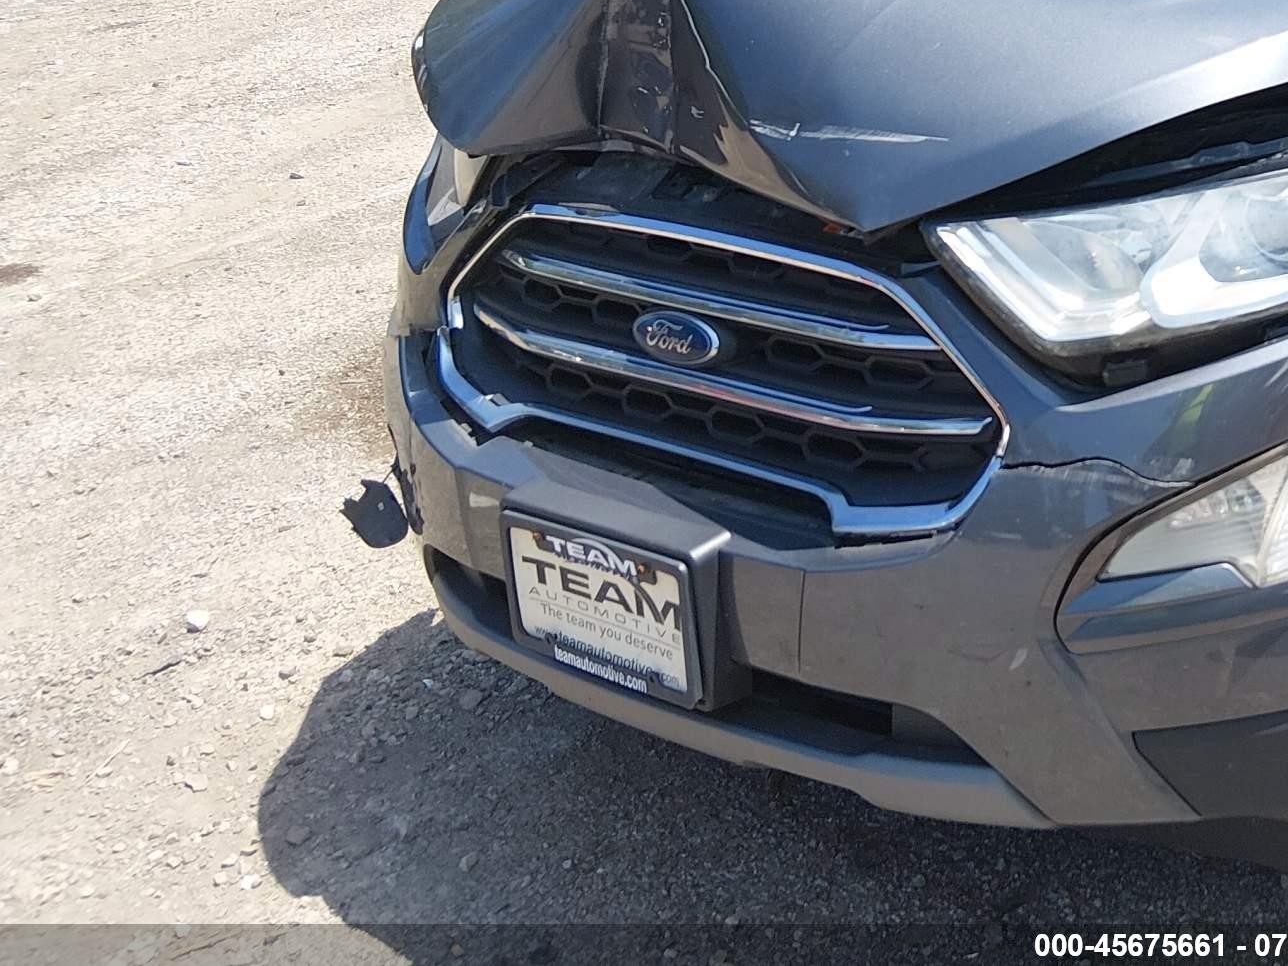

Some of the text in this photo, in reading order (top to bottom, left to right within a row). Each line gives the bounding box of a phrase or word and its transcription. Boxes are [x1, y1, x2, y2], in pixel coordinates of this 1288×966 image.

[646, 319, 693, 354] Ford
[546, 535, 637, 575] TEAM
[521, 555, 680, 632] TEAM
[528, 586, 680, 645] AUTOMOTIVE
[540, 602, 673, 661] The team you deserve
[554, 643, 647, 694] teamautomotive.com
